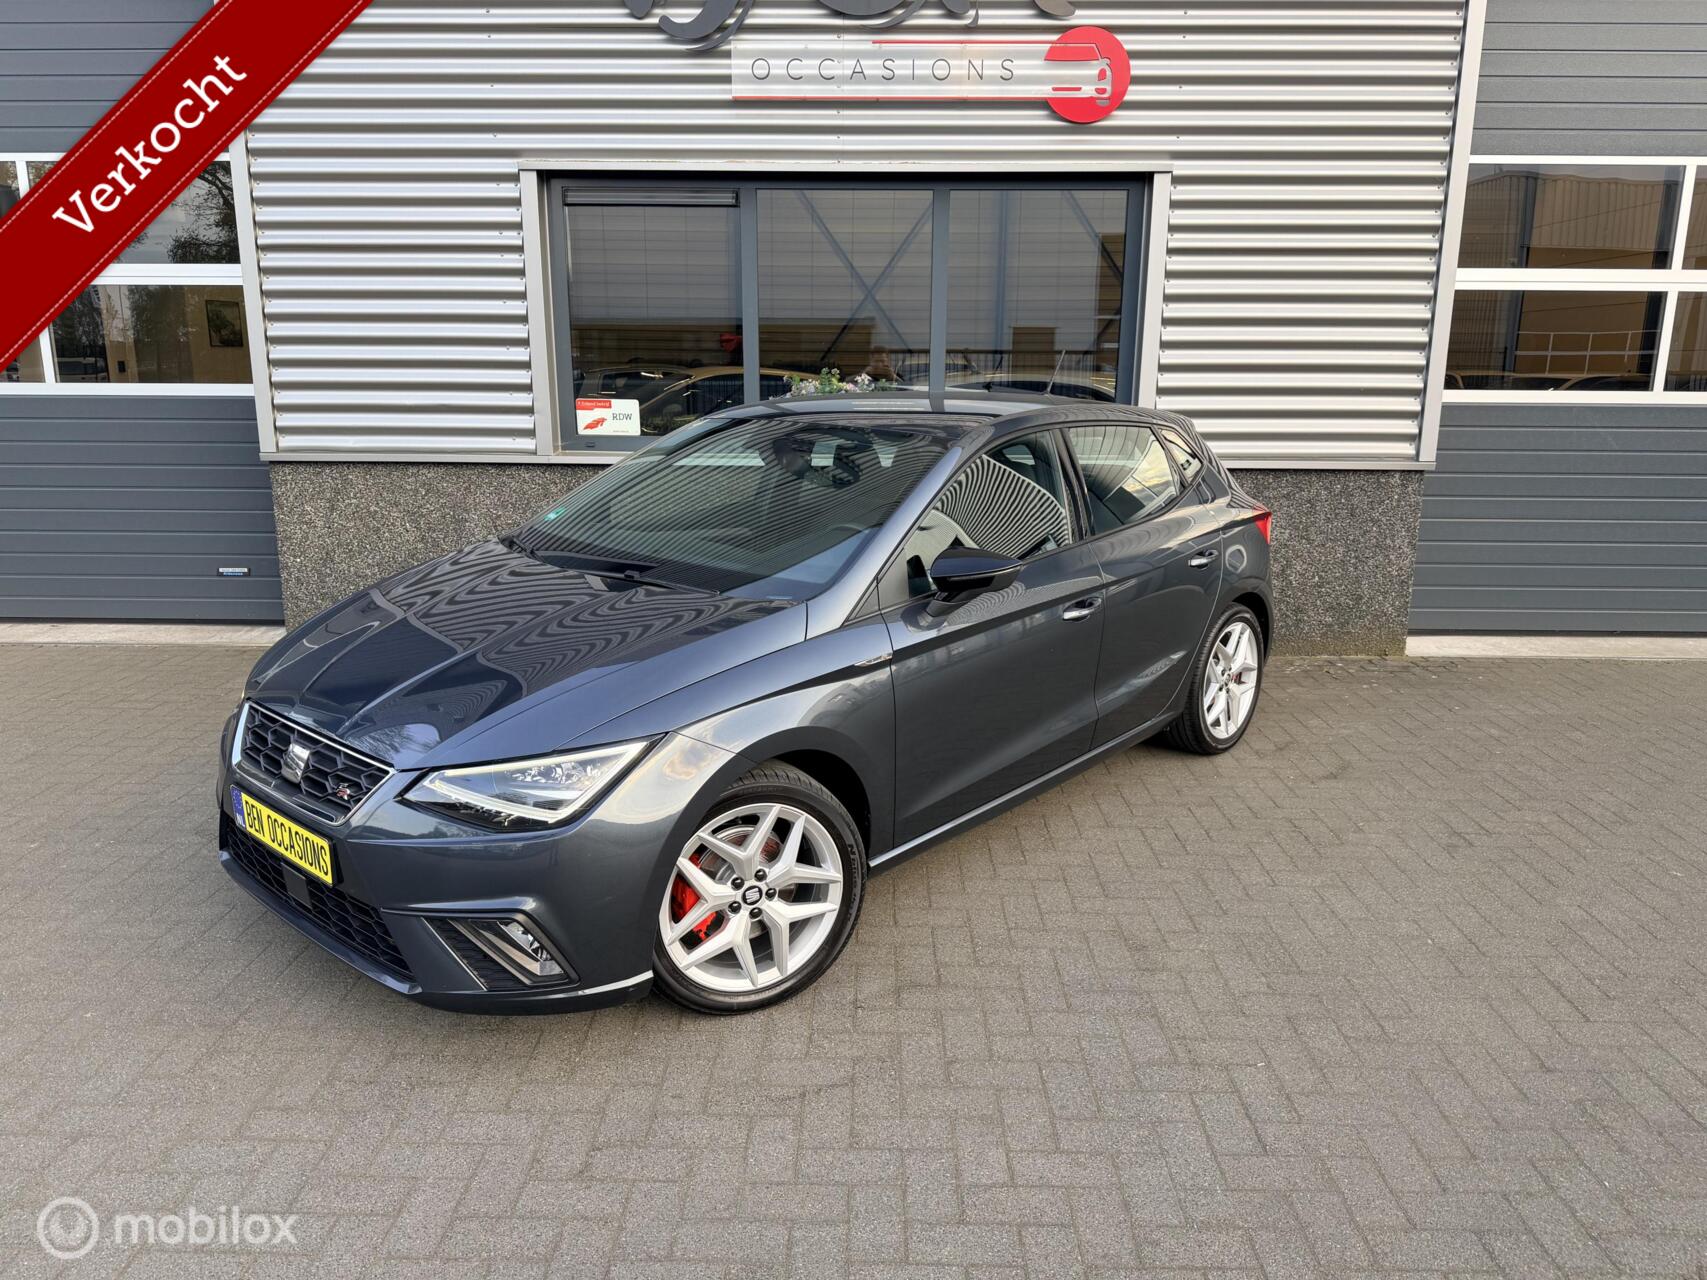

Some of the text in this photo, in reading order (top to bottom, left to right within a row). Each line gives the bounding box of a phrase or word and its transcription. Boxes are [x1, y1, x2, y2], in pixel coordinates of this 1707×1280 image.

[751, 58, 1015, 81] OCCASIONS
[612, 412, 633, 421] RDW
[245, 800, 329, 876] BEN OCCASIONS
